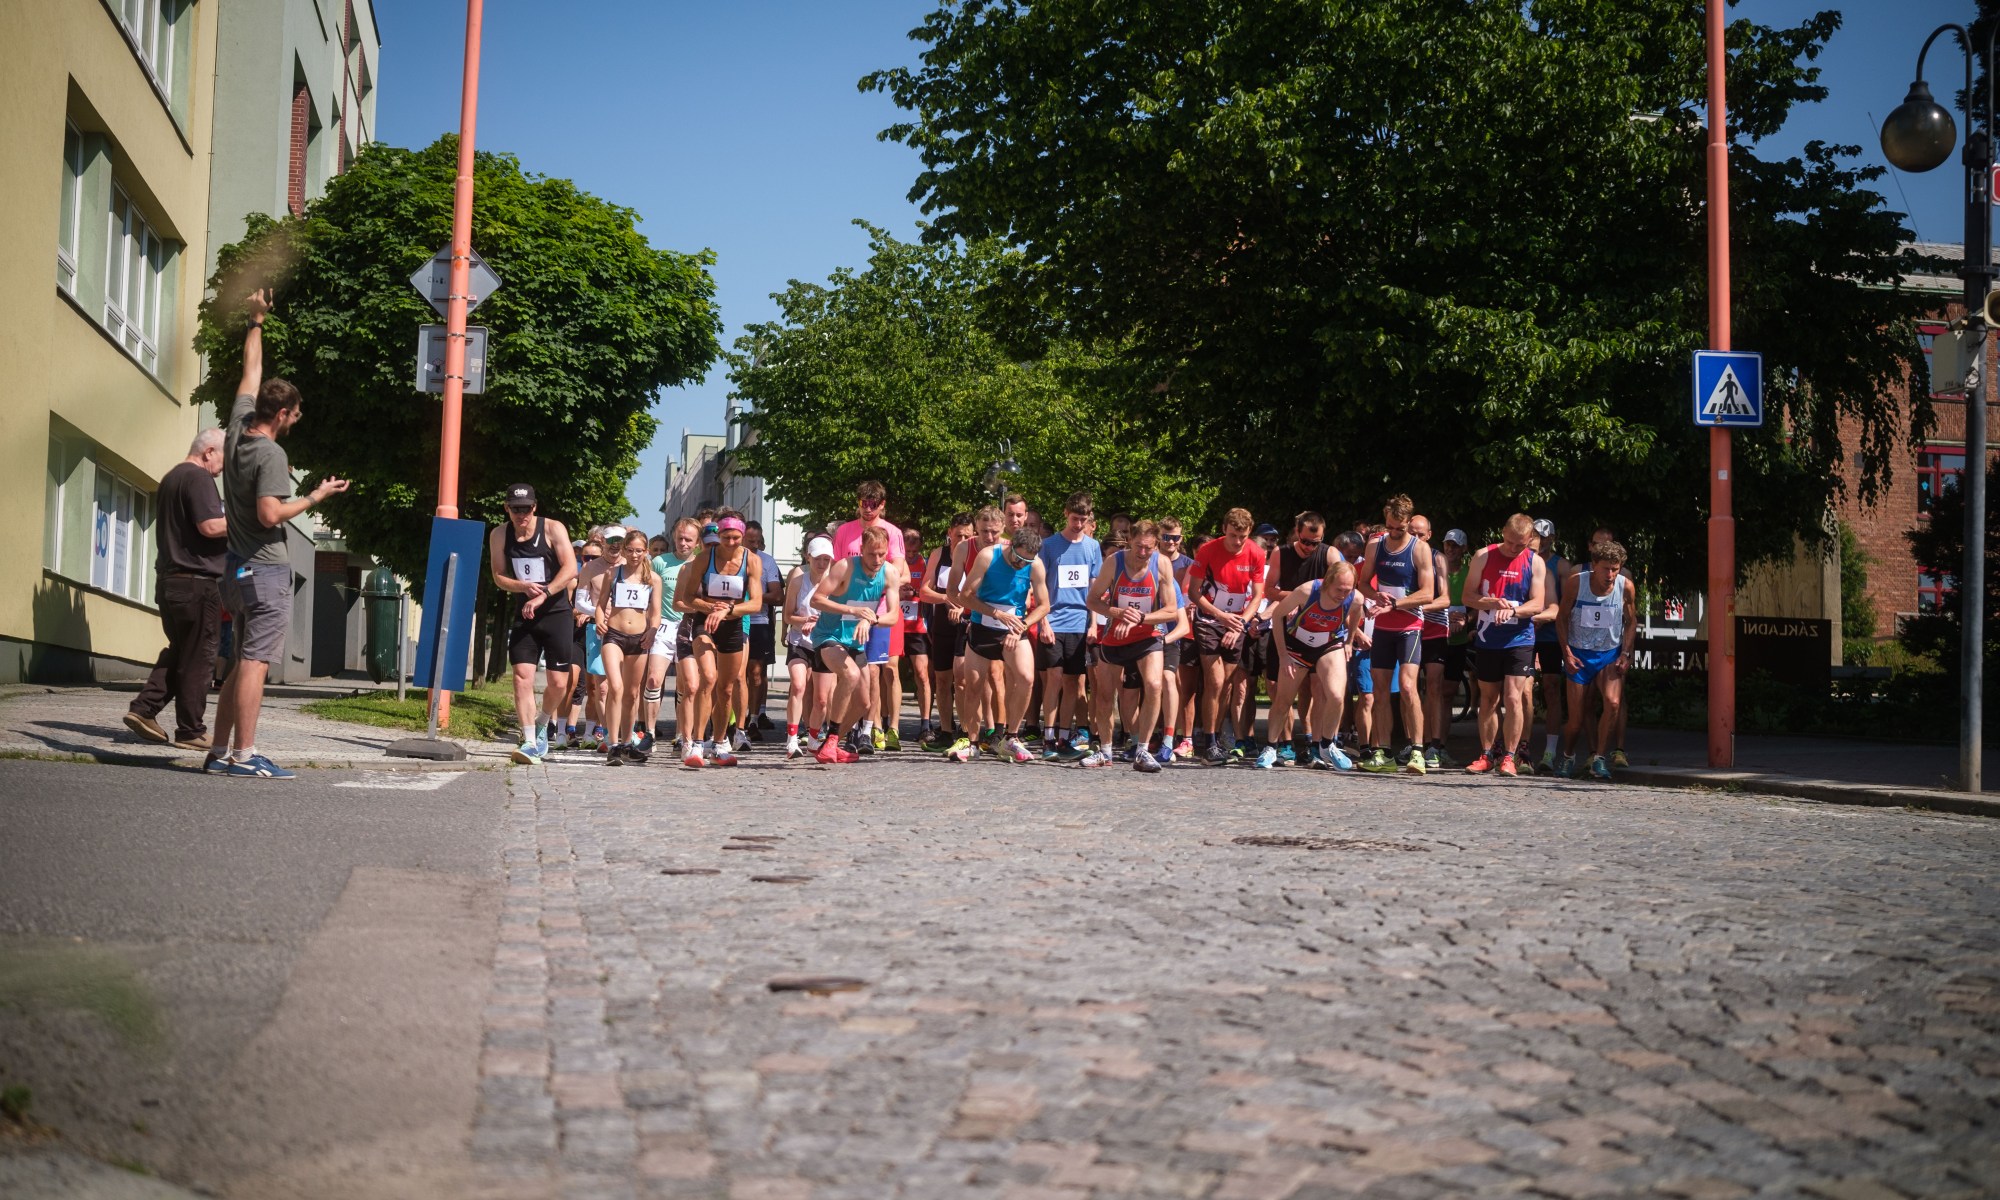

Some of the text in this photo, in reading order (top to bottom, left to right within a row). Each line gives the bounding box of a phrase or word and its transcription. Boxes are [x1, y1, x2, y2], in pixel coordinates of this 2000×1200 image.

[524, 563, 531, 575] 8
[1067, 570, 1080, 581] 26
[721, 580, 730, 591] 11
[626, 589, 639, 601] 73
[1227, 597, 1234, 607] 6
[1594, 611, 1601, 622] 9
[1308, 635, 1315, 643] 2
